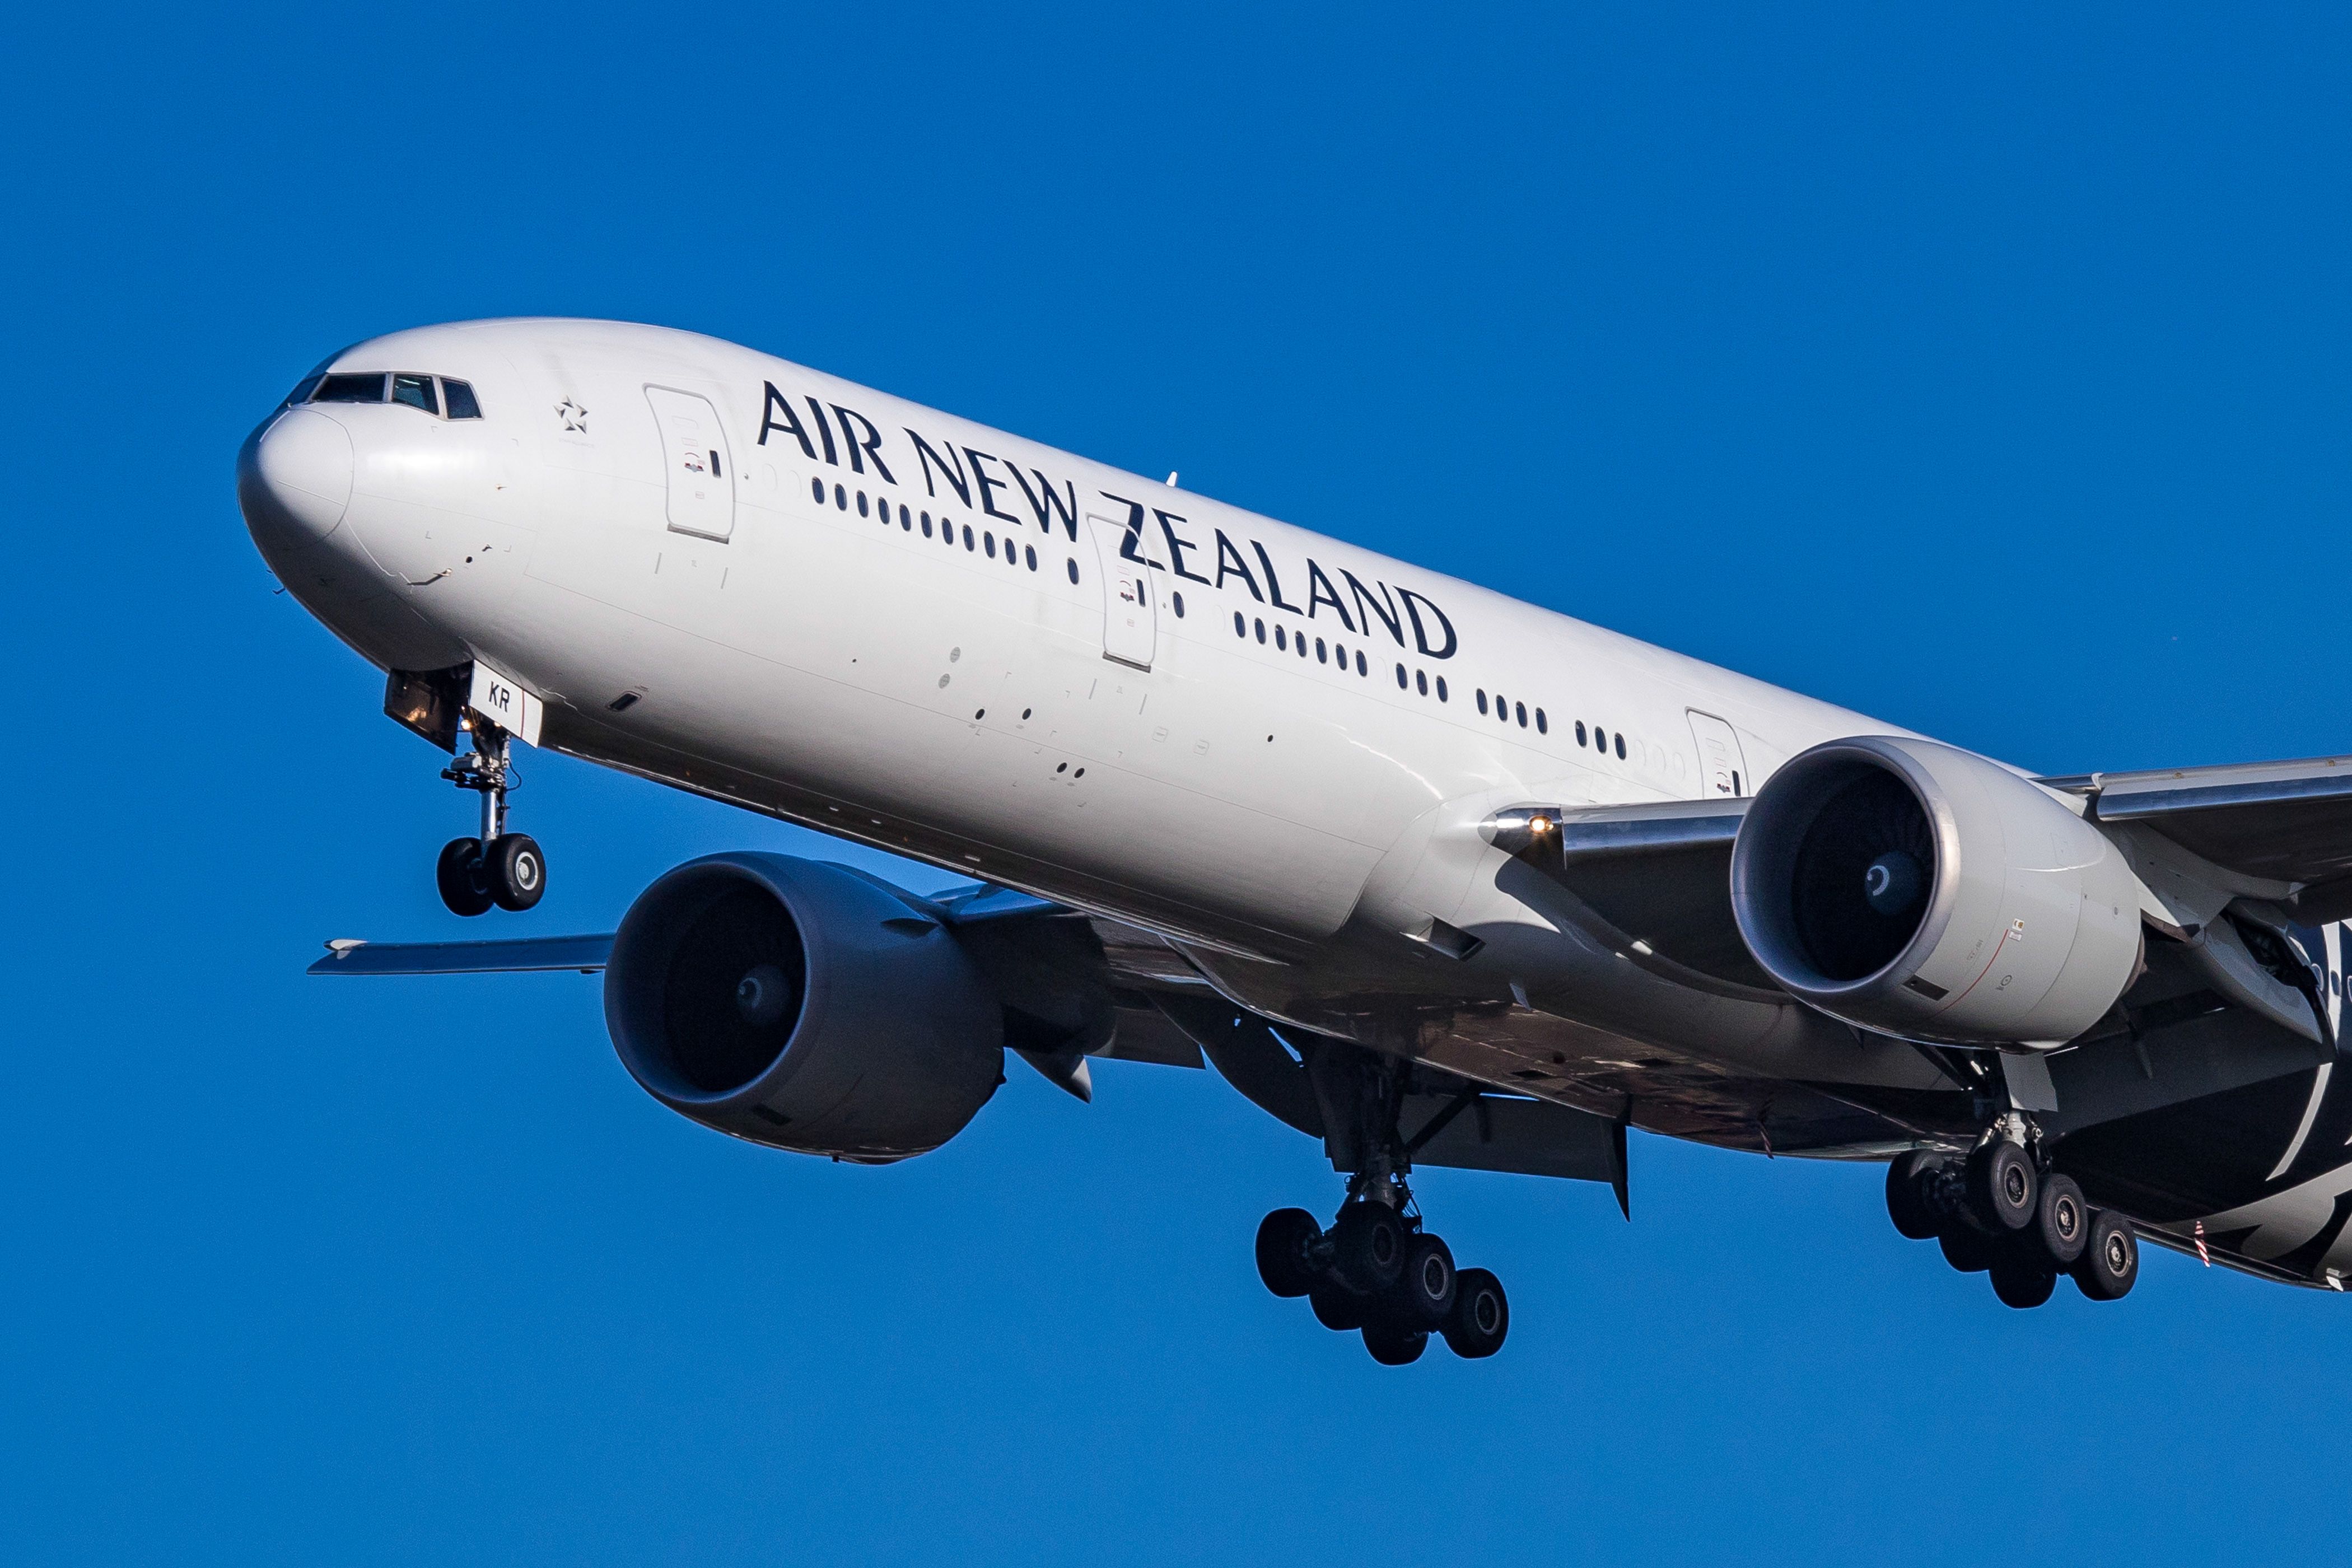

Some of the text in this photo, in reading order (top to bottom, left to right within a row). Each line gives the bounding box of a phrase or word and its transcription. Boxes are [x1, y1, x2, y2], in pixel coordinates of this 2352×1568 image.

[757, 380, 1457, 660] AIR NEW ZEALAND
[489, 680, 510, 713] KR
